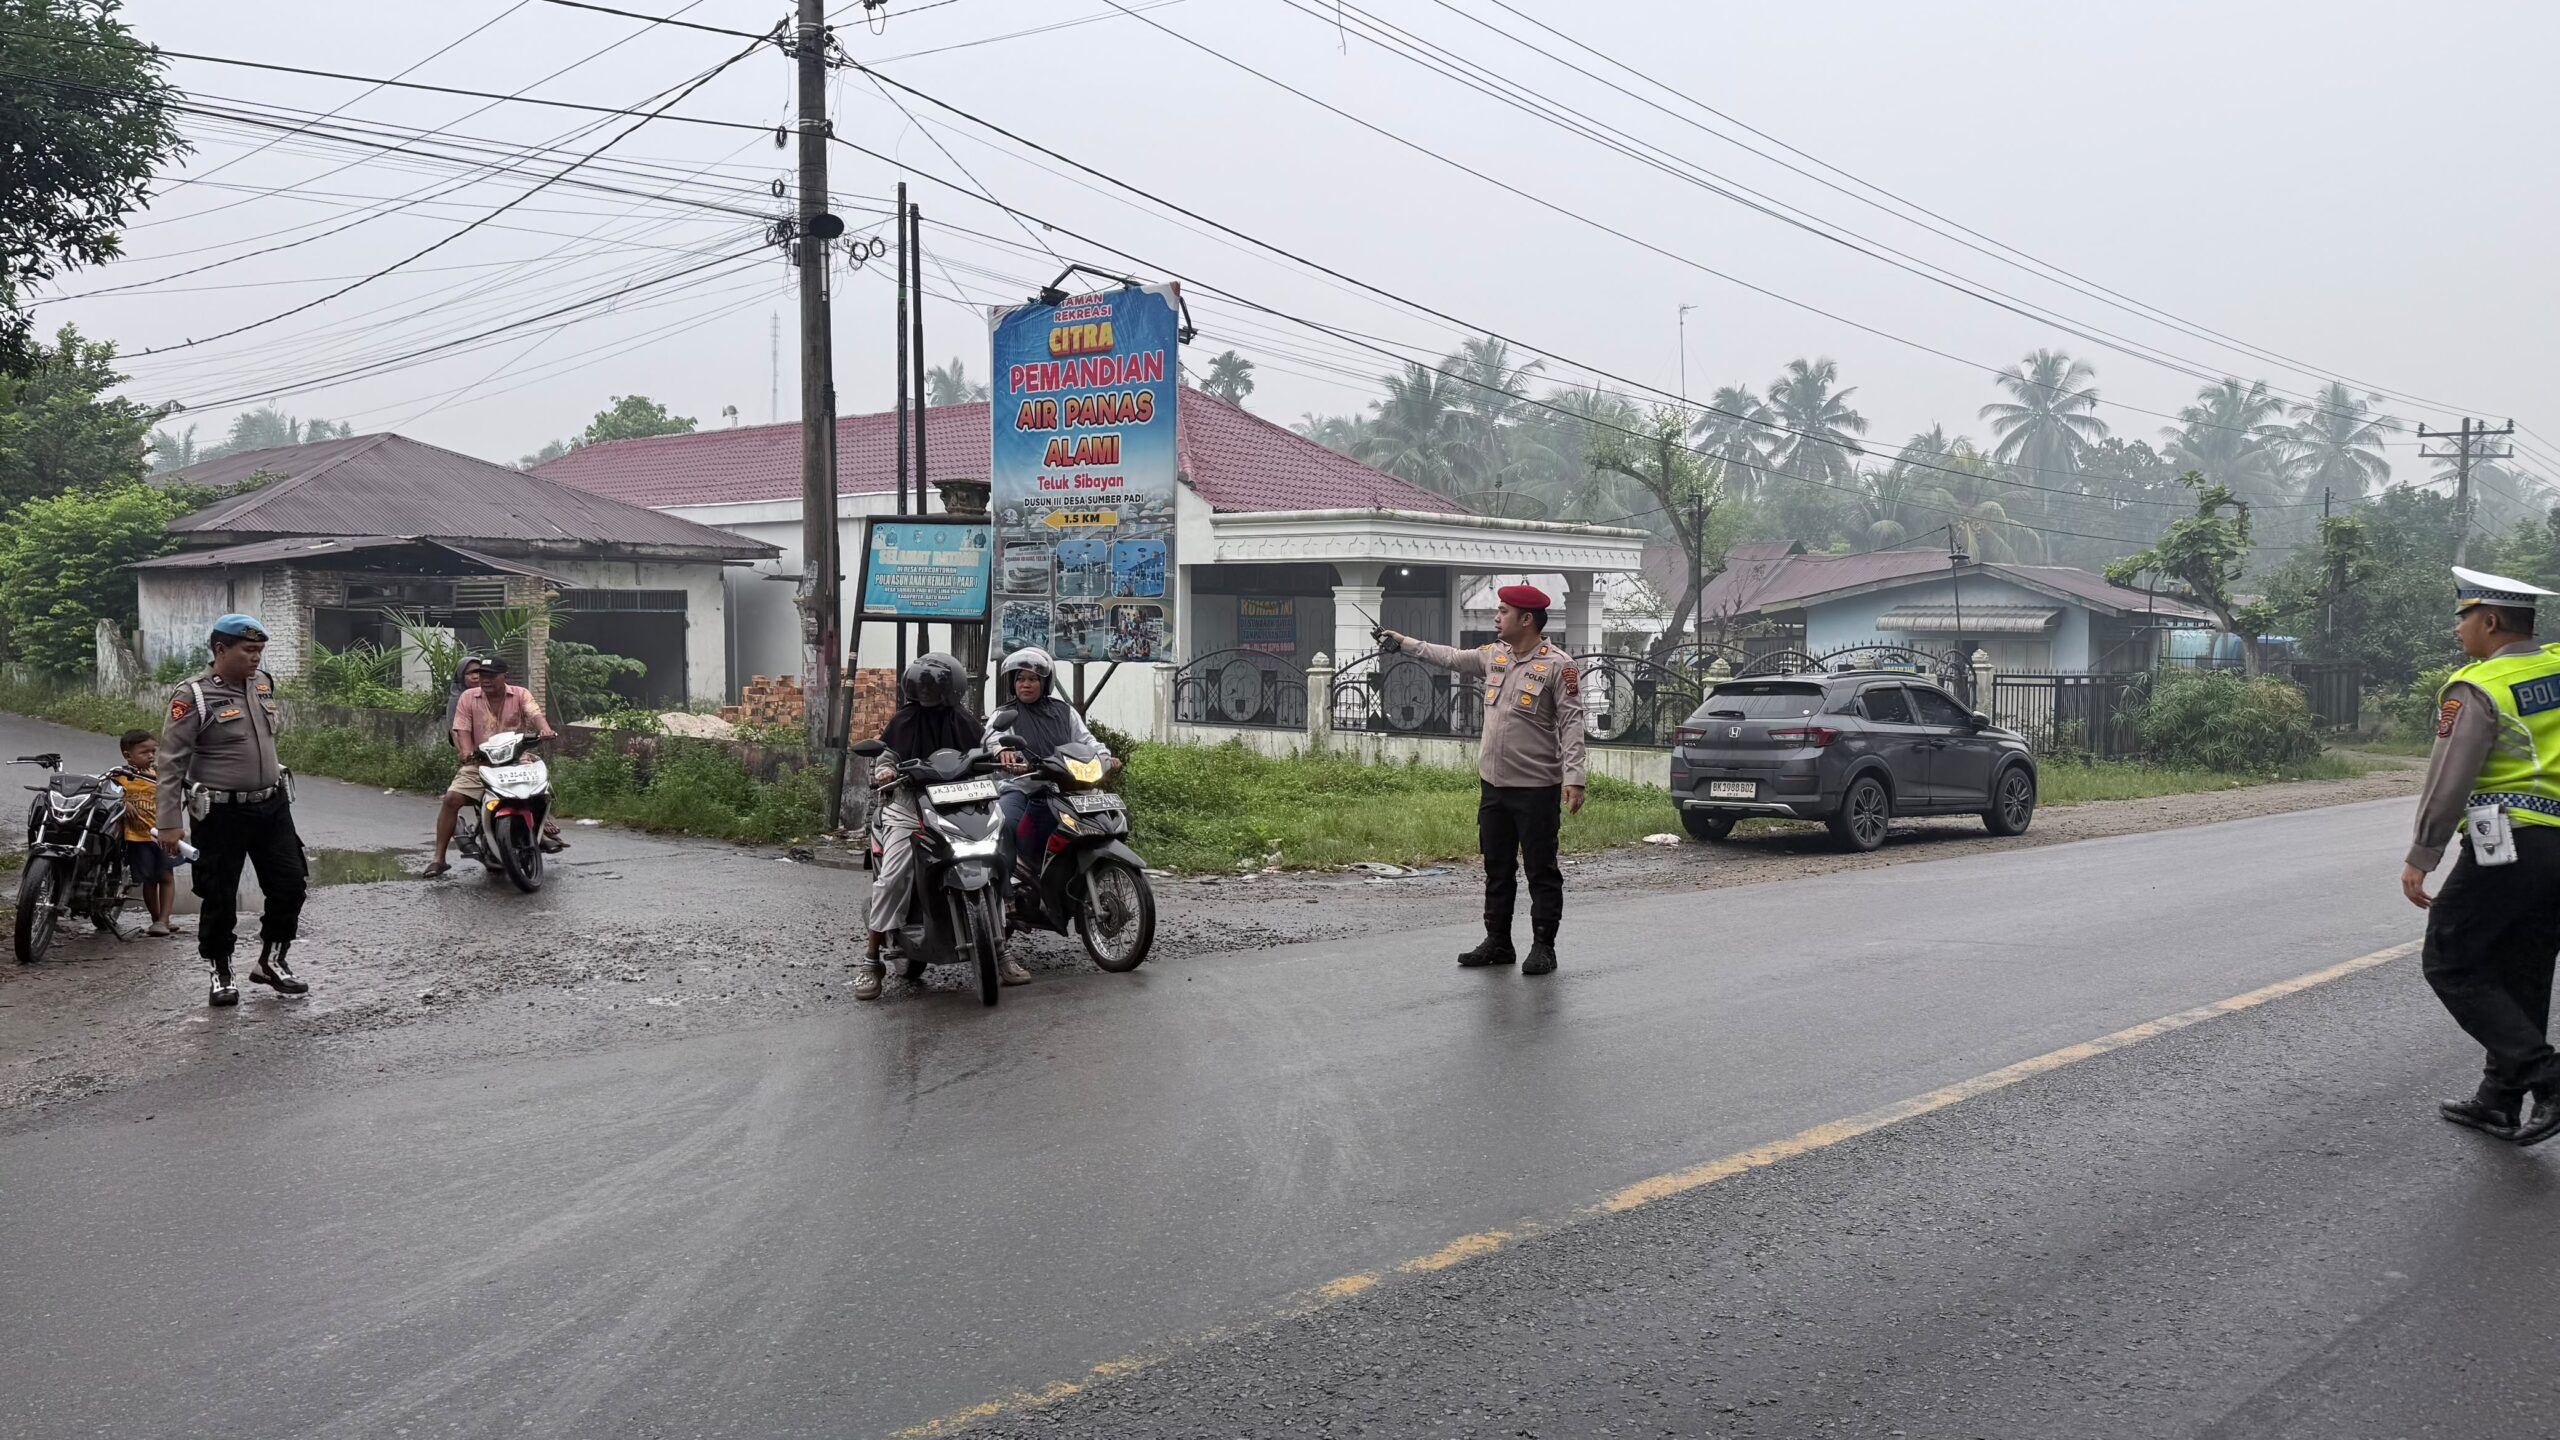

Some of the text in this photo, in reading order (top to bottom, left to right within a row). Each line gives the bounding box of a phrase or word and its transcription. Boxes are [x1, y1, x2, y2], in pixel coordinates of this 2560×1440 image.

[1054, 304, 1112, 323] REKREASI
[1049, 322, 1114, 356] CITRA
[1010, 350, 1164, 394] PEMANDIAN
[1015, 391, 1154, 431] AIR PANAS
[1043, 435, 1120, 468] ALAMI
[1036, 473, 1124, 492] Teluk Sibayan
[1024, 494, 1144, 507] DUSUN III DESA SUMBER PADI
[1082, 514, 1100, 523] KM
[1523, 671, 1545, 684] POLRI
[2517, 681, 2560, 709] POL
